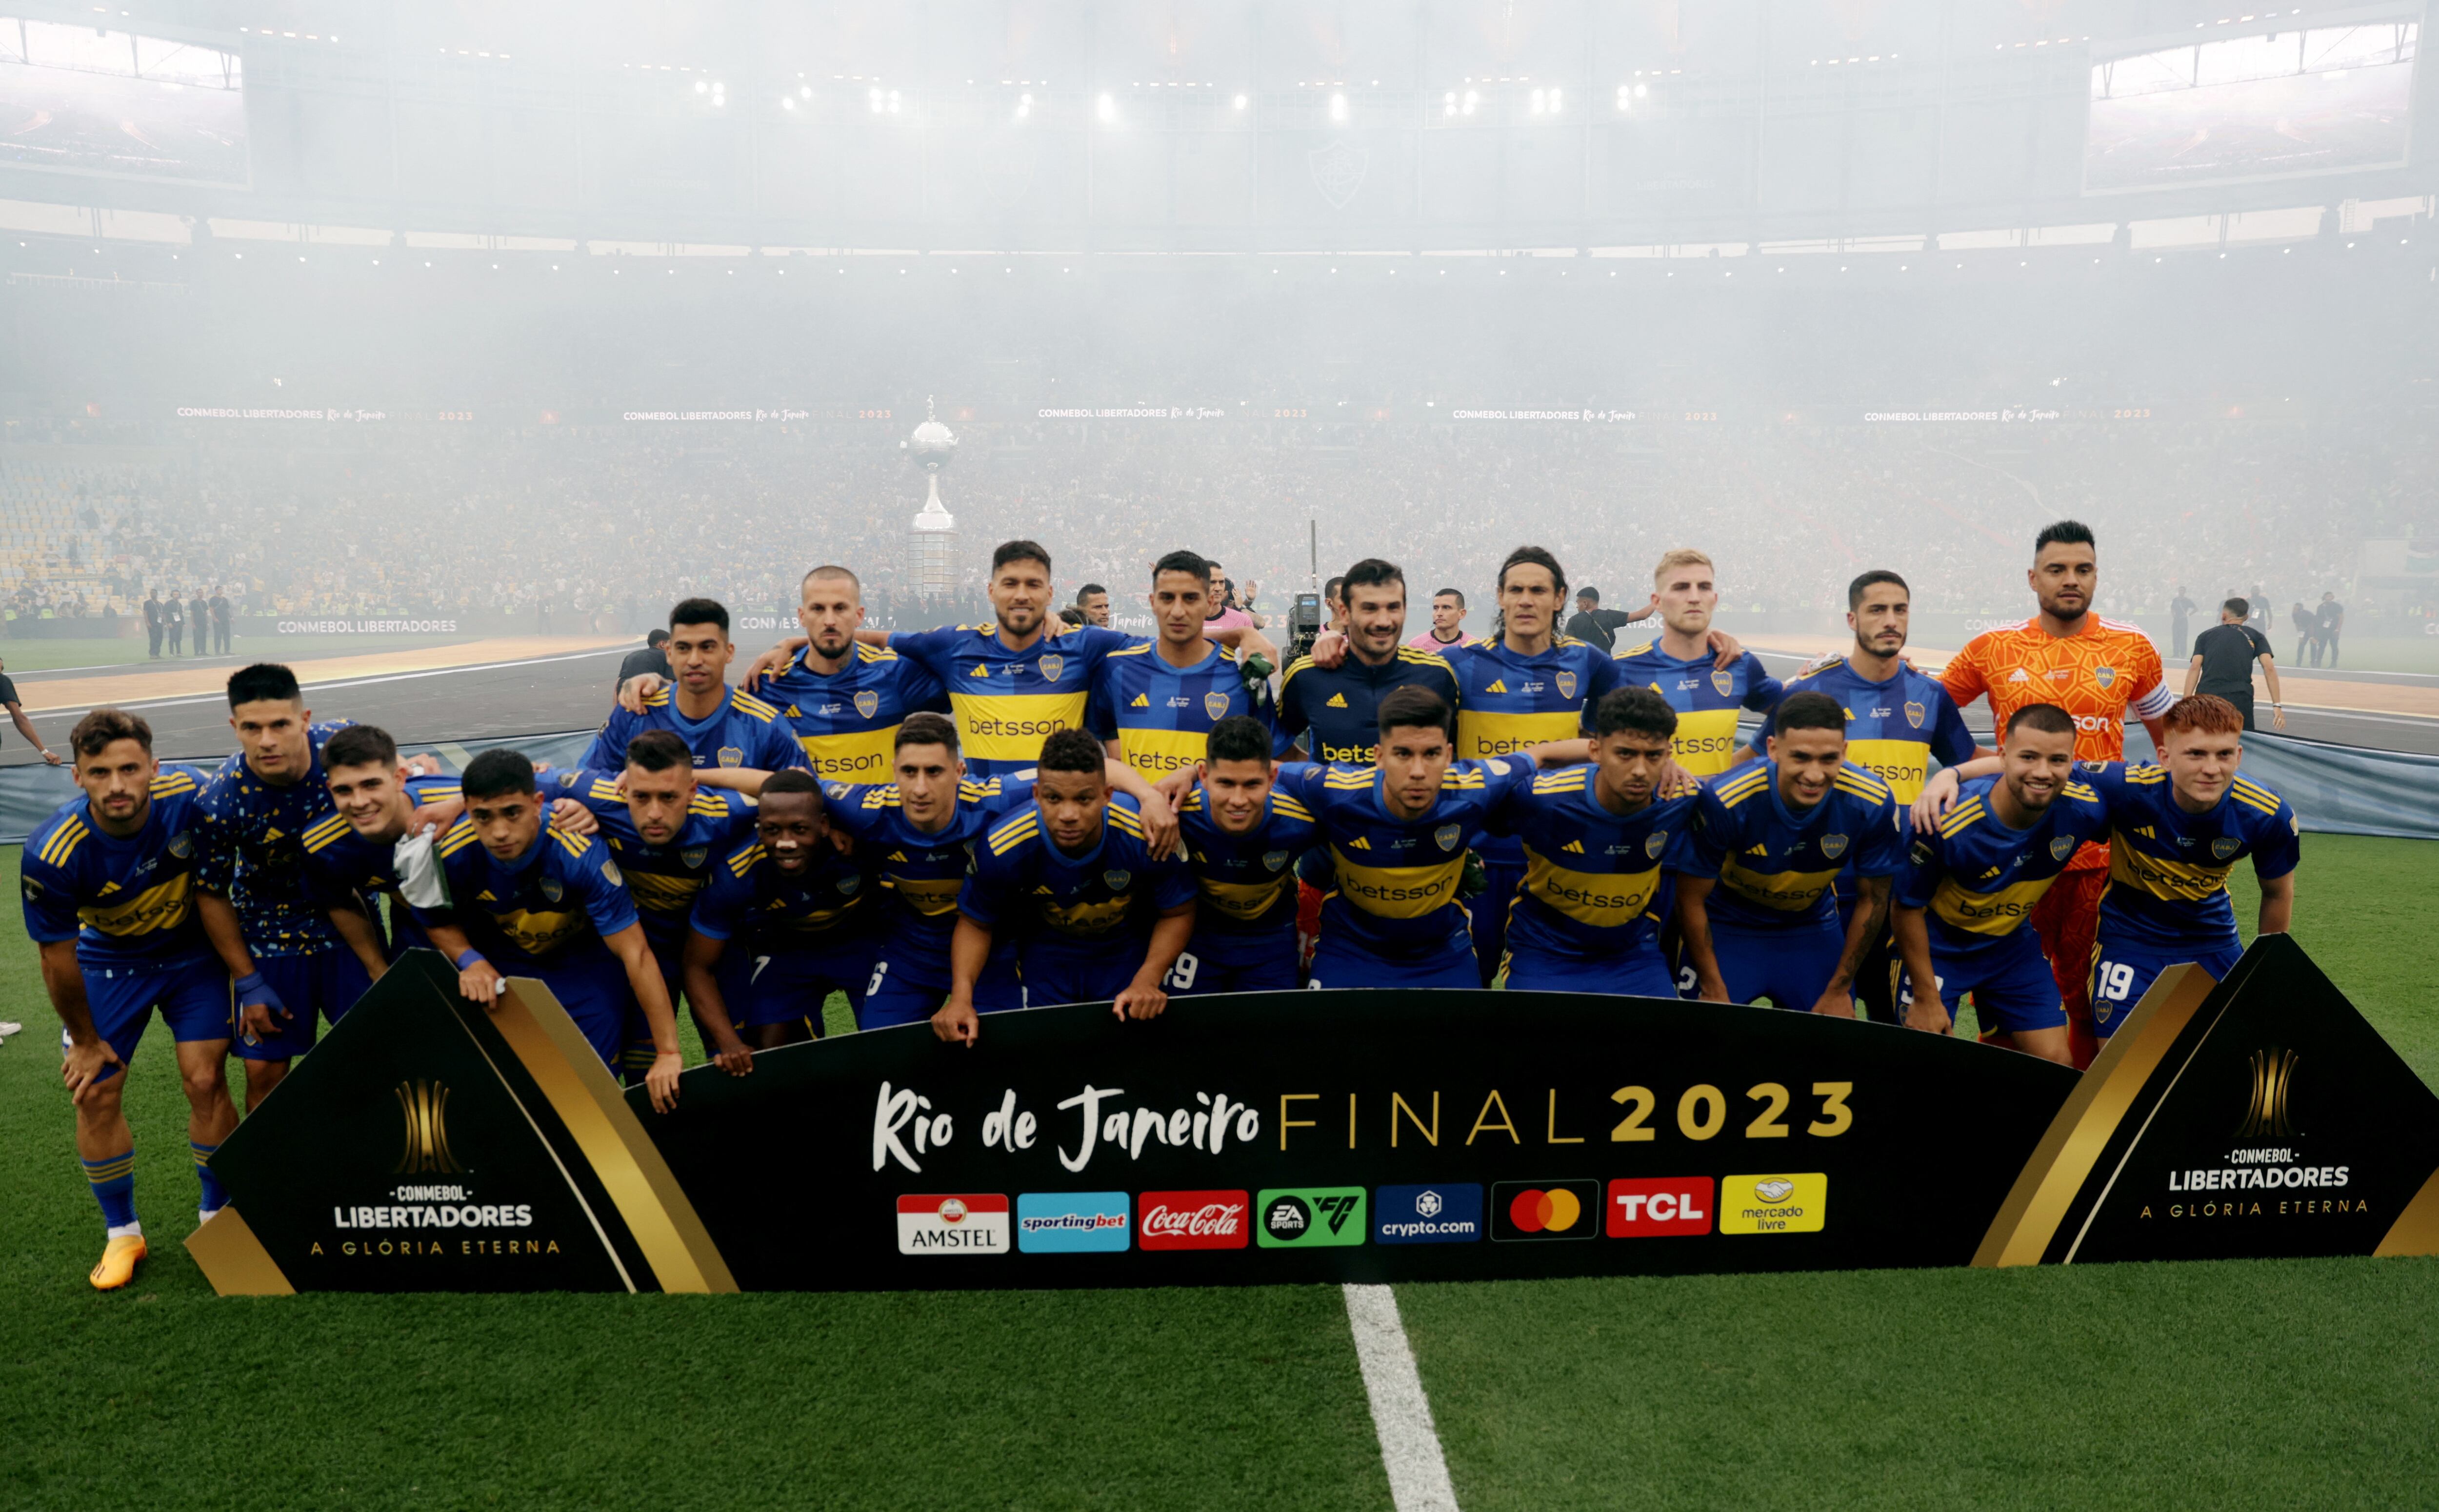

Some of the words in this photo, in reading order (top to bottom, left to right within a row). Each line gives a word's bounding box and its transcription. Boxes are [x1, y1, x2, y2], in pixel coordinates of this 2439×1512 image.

[177, 407, 241, 418] CONMEBOL
[243, 408, 323, 419] LIBERTADORES
[326, 407, 340, 421] Rio
[343, 410, 353, 420] de
[355, 409, 386, 422] Janeiro
[439, 411, 473, 420] 2023
[623, 412, 680, 420] CONMEBOL
[681, 411, 752, 420] LIBERTADORES
[756, 409, 767, 422] Rio
[770, 411, 779, 419] de
[781, 410, 809, 422] Janeiro
[859, 410, 891, 418] 2023
[1038, 409, 1094, 418] CONMEBOL
[1096, 408, 1167, 418] LIBERTADORES
[1171, 407, 1183, 419] Rio
[1186, 408, 1194, 417] de
[1197, 407, 1225, 419] Janeiro
[1274, 409, 1308, 418] 2023
[1453, 410, 1507, 419] CONMEBOL
[1510, 410, 1579, 419] LIBERTADORES
[1583, 410, 1595, 422] Rio
[1598, 411, 1606, 419] de
[1608, 410, 1636, 422] Janeiro
[1685, 411, 1717, 420] 2023
[1864, 413, 1921, 421] CONMEBOL
[1923, 412, 1998, 421] LIBERTADORES
[2001, 409, 2015, 422] Rio
[2018, 410, 2027, 419] de
[2029, 410, 2060, 422] Janeiro
[2114, 409, 2151, 418] 2023
[277, 621, 355, 634] CONMEBOL
[357, 620, 457, 633] LIBERTADORES
[739, 617, 800, 629] CONMEB
[1109, 612, 1153, 630] Janeiro
[969, 716, 1065, 736] betsson
[1322, 742, 1376, 763] bets
[812, 752, 883, 775] tsson
[1729, 871, 1822, 900] betsso
[1959, 900, 2036, 918] betss
[2097, 961, 2135, 1001] 19
[873, 1081, 954, 1173] Rio
[981, 1089, 1037, 1153] de
[1057, 1084, 1259, 1173] Janeiro
[1279, 1088, 1585, 1152] FINAL
[1610, 1081, 1853, 1142] 2023
[2169, 1166, 2350, 1192] LIBERTADORES
[1271, 1205, 1304, 1221] EA
[1616, 1193, 1704, 1221] TCL
[1741, 1206, 1803, 1219] mercado
[2140, 1206, 2152, 1219] A
[2170, 1200, 2261, 1218] GLÓRIA
[2279, 1199, 2368, 1214] ETERNA
[334, 1204, 533, 1229] LIBERTADORES
[1021, 1214, 1125, 1232] sportingbet
[1142, 1204, 1243, 1237] Coca-Cola
[1271, 1221, 1304, 1230] SPORTS
[1758, 1218, 1786, 1230] livre
[1381, 1220, 1475, 1236] crypto.com
[310, 1241, 324, 1255] A
[341, 1238, 443, 1255] GLÓRIA
[461, 1239, 560, 1255] ETERNA
[912, 1229, 996, 1248] AMSTEL
